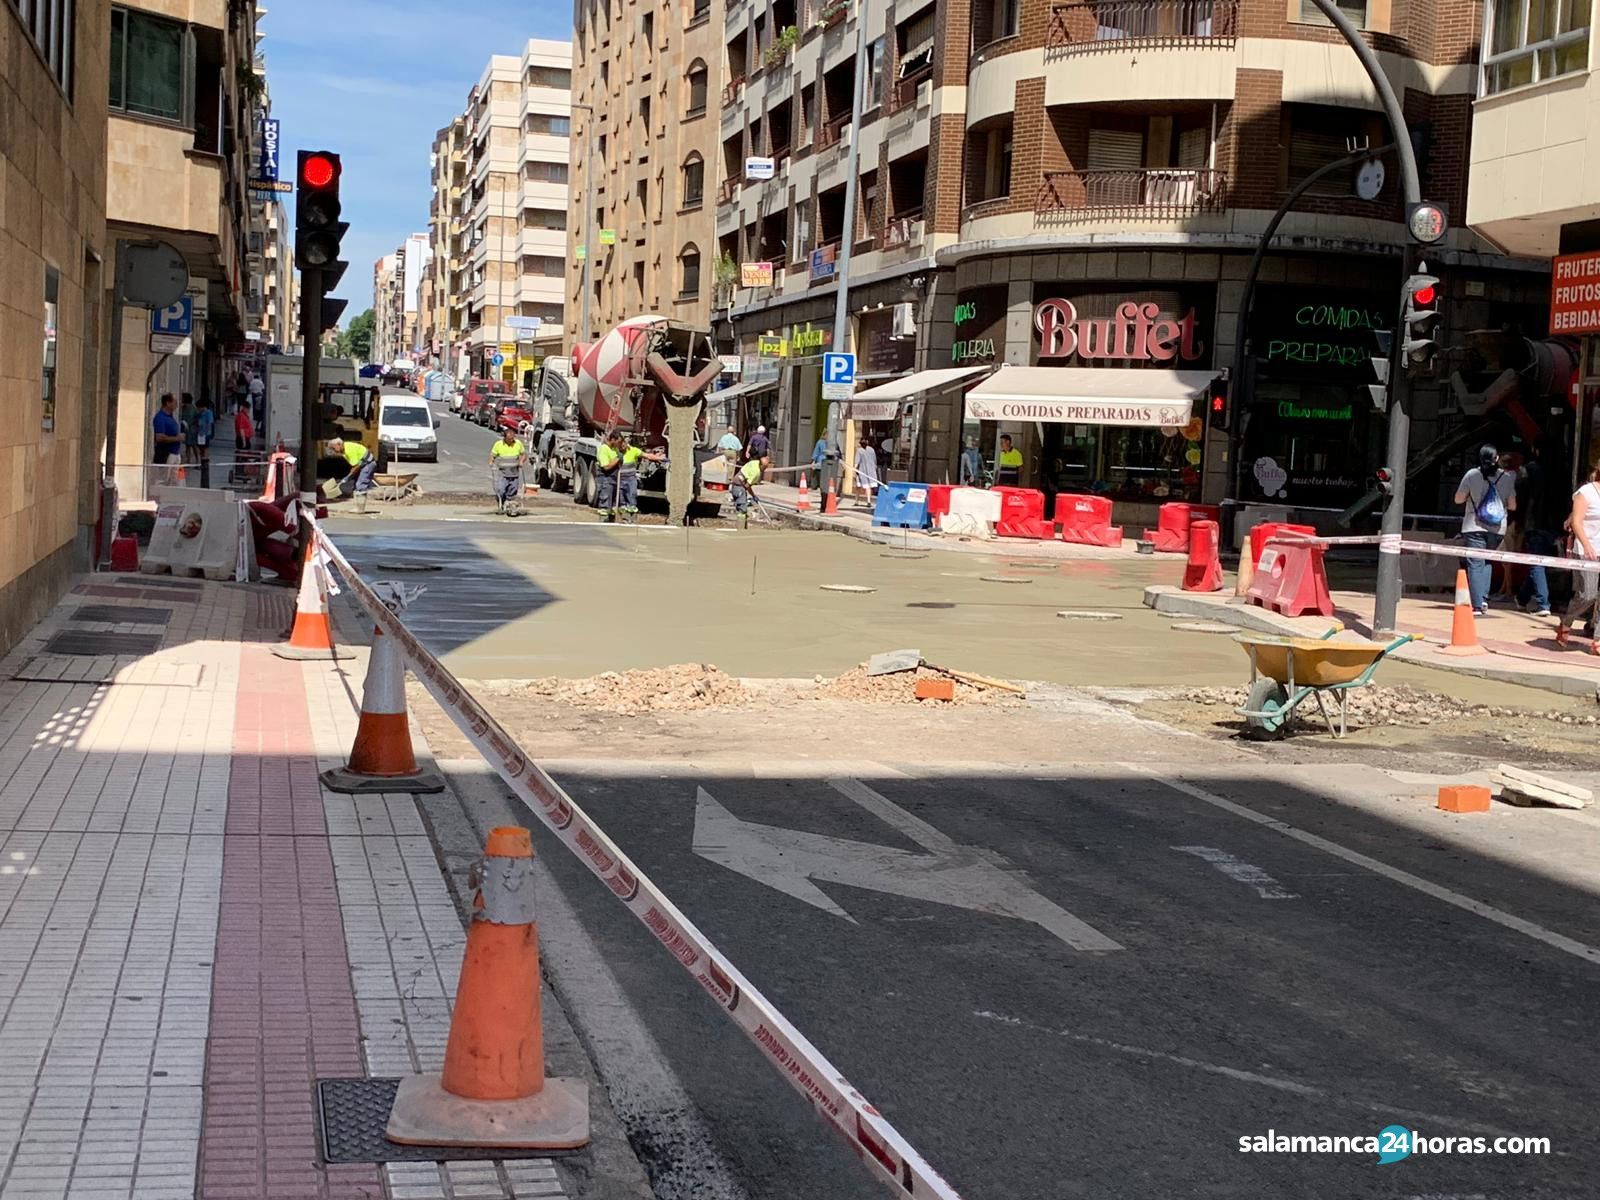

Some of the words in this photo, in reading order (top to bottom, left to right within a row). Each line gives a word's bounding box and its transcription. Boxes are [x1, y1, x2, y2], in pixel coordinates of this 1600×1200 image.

[264, 121, 277, 177] HOSTAL
[1555, 282, 1600, 305] FRUTOS
[1034, 298, 1203, 360] Buffet
[1295, 304, 1383, 331] COMIDAS
[1553, 308, 1600, 330] BEBIDA
[1267, 340, 1372, 366] PREPARA
[830, 357, 848, 380] P
[1002, 404, 1063, 418] COMIDAS
[1067, 406, 1151, 421] PREPARADAS
